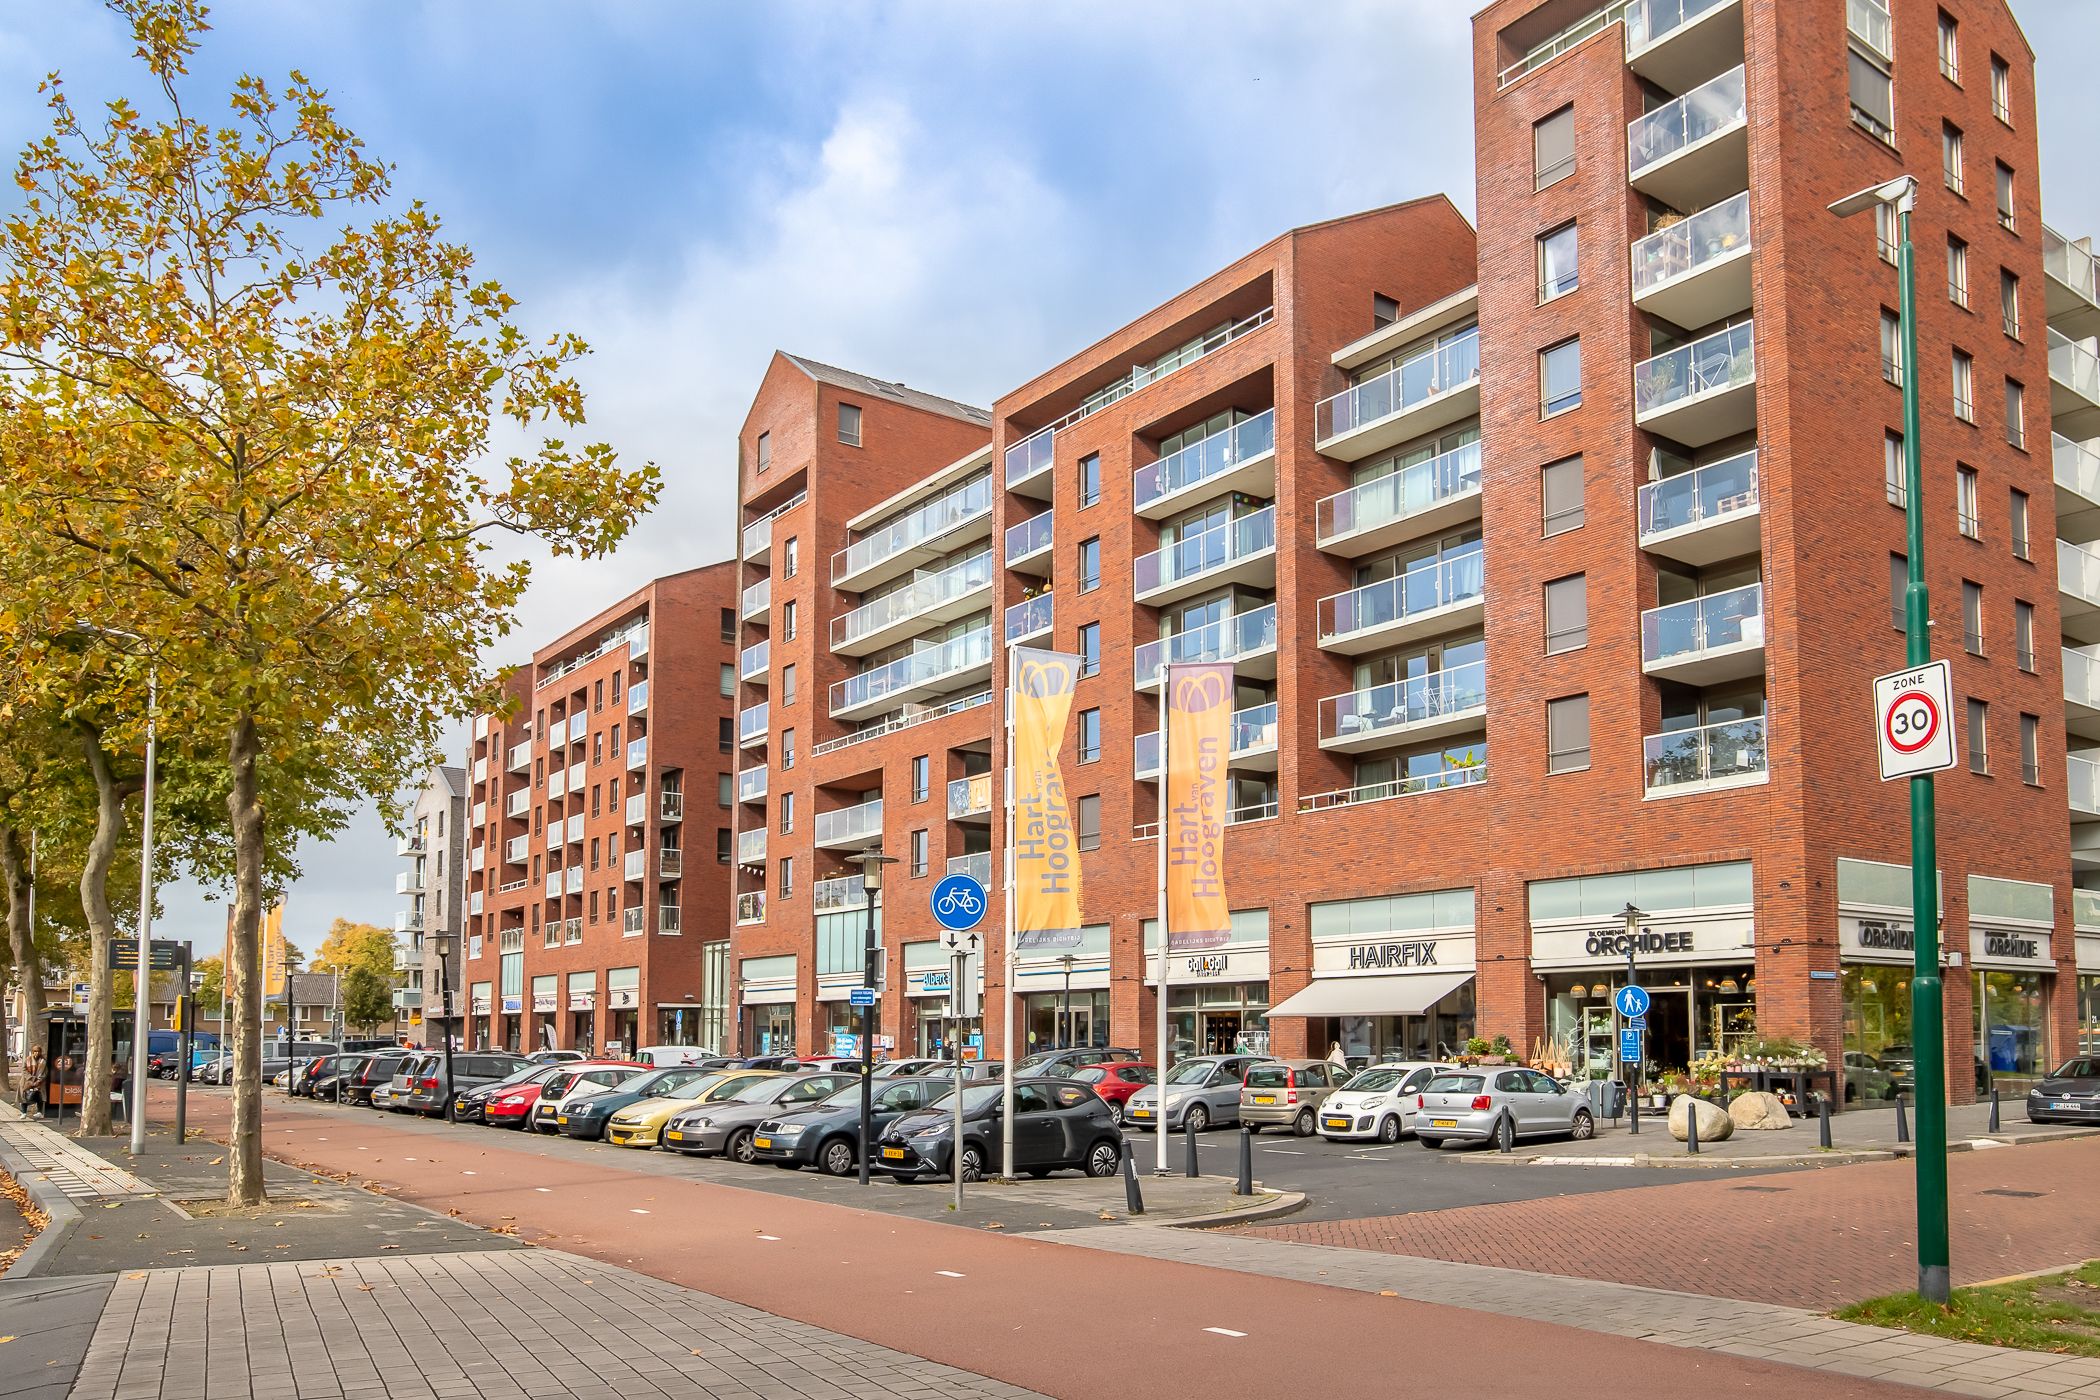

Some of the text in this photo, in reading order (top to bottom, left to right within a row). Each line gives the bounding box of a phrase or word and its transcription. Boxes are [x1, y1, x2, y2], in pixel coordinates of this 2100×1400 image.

[1893, 674, 1925, 690] ZONE
[1895, 708, 1928, 735] 30
[1018, 793, 1046, 860] Hart
[1171, 783, 1199, 866] Hart van
[1191, 737, 1221, 898] Hoograven
[1350, 942, 1437, 969] HAIRFIX
[923, 972, 947, 985] Albert
